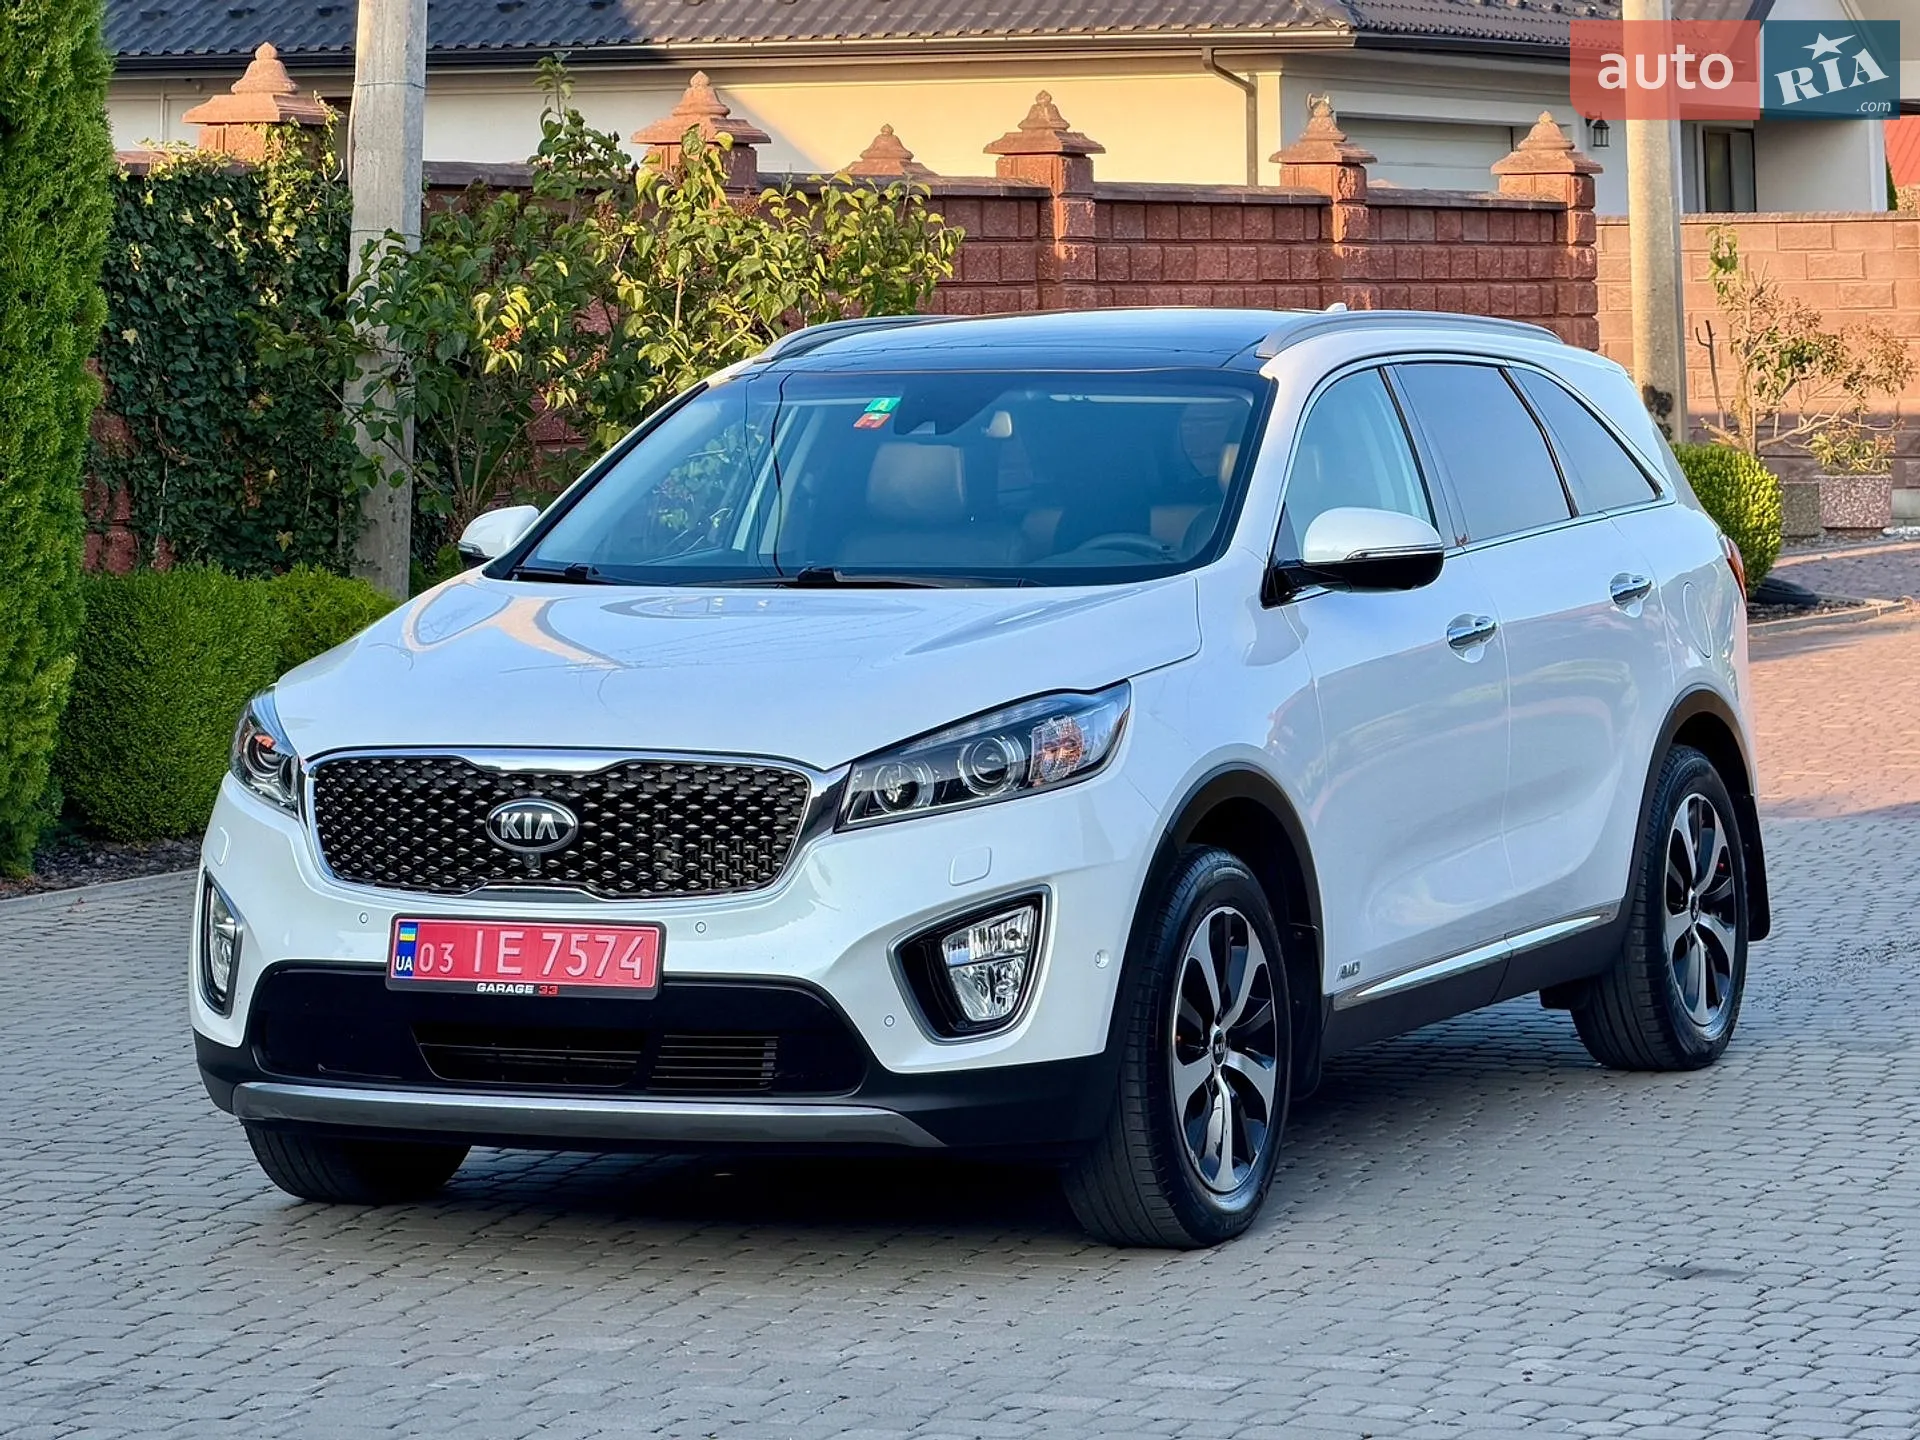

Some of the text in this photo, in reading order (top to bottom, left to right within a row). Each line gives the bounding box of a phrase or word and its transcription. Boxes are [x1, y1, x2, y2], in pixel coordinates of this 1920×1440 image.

[501, 812, 559, 839] KIA
[395, 956, 414, 971] UA
[419, 943, 454, 973] 03
[541, 933, 643, 979] 7574
[476, 982, 559, 995] GARAGE 33
